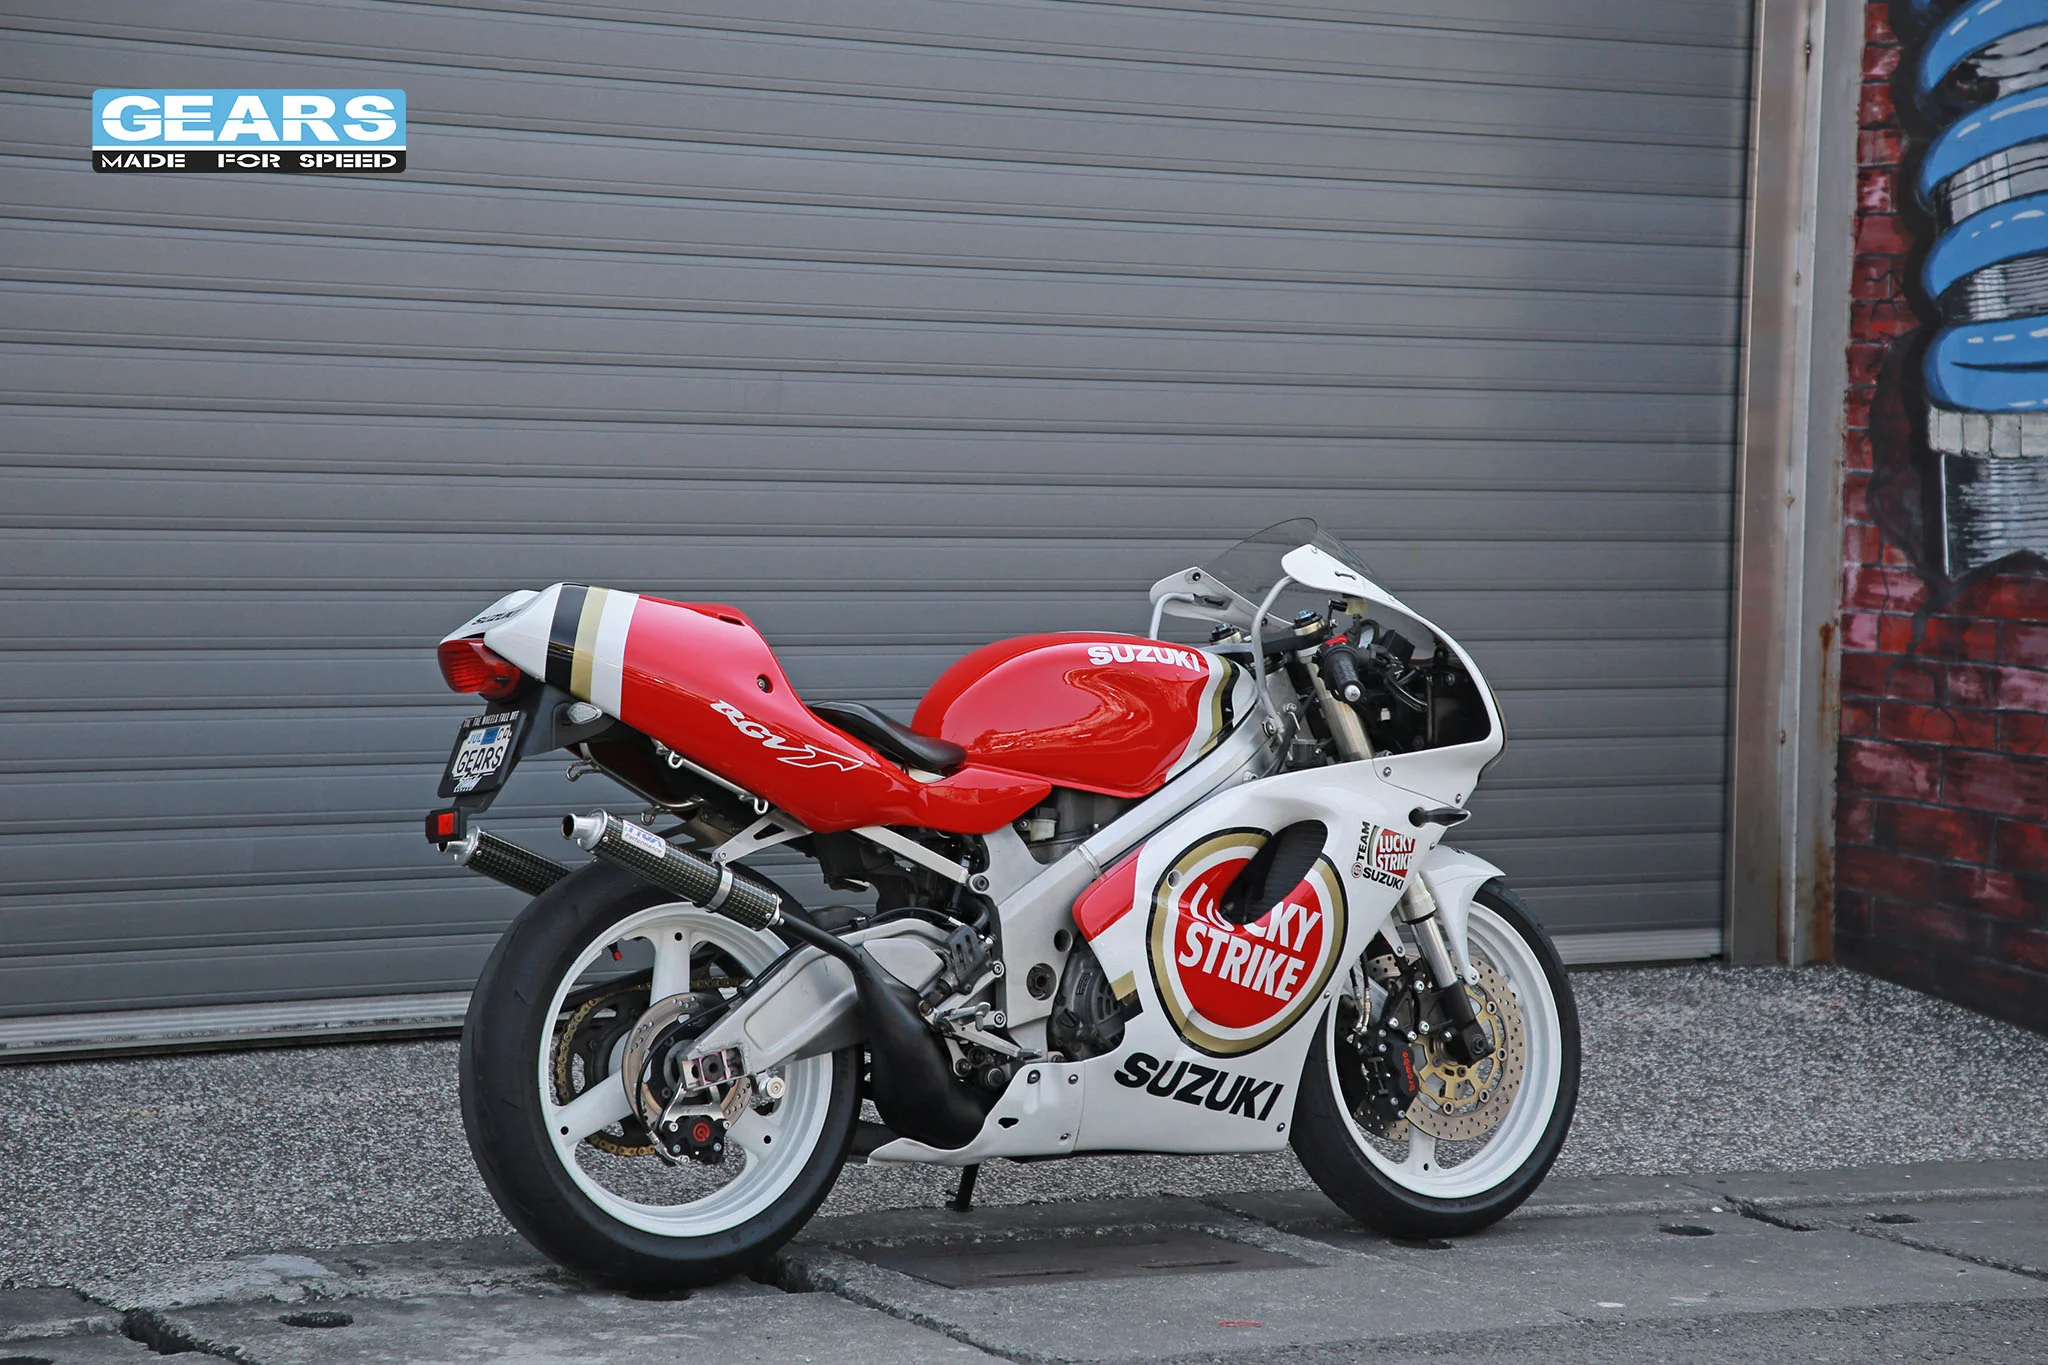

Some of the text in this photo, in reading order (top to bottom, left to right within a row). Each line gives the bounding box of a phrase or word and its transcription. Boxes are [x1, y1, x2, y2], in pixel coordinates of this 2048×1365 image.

[1087, 645, 1201, 673] SUZUKI
[456, 746, 504, 774] GEARS
[624, 832, 664, 854] Performance
[1356, 821, 1370, 861] TEAM
[1379, 834, 1415, 853] LUCKY
[1362, 867, 1404, 890] SUZUKI
[1178, 921, 1306, 1002] STRIKE
[1402, 1050, 1416, 1092] brembo
[1113, 1052, 1285, 1122] SUZUKI
